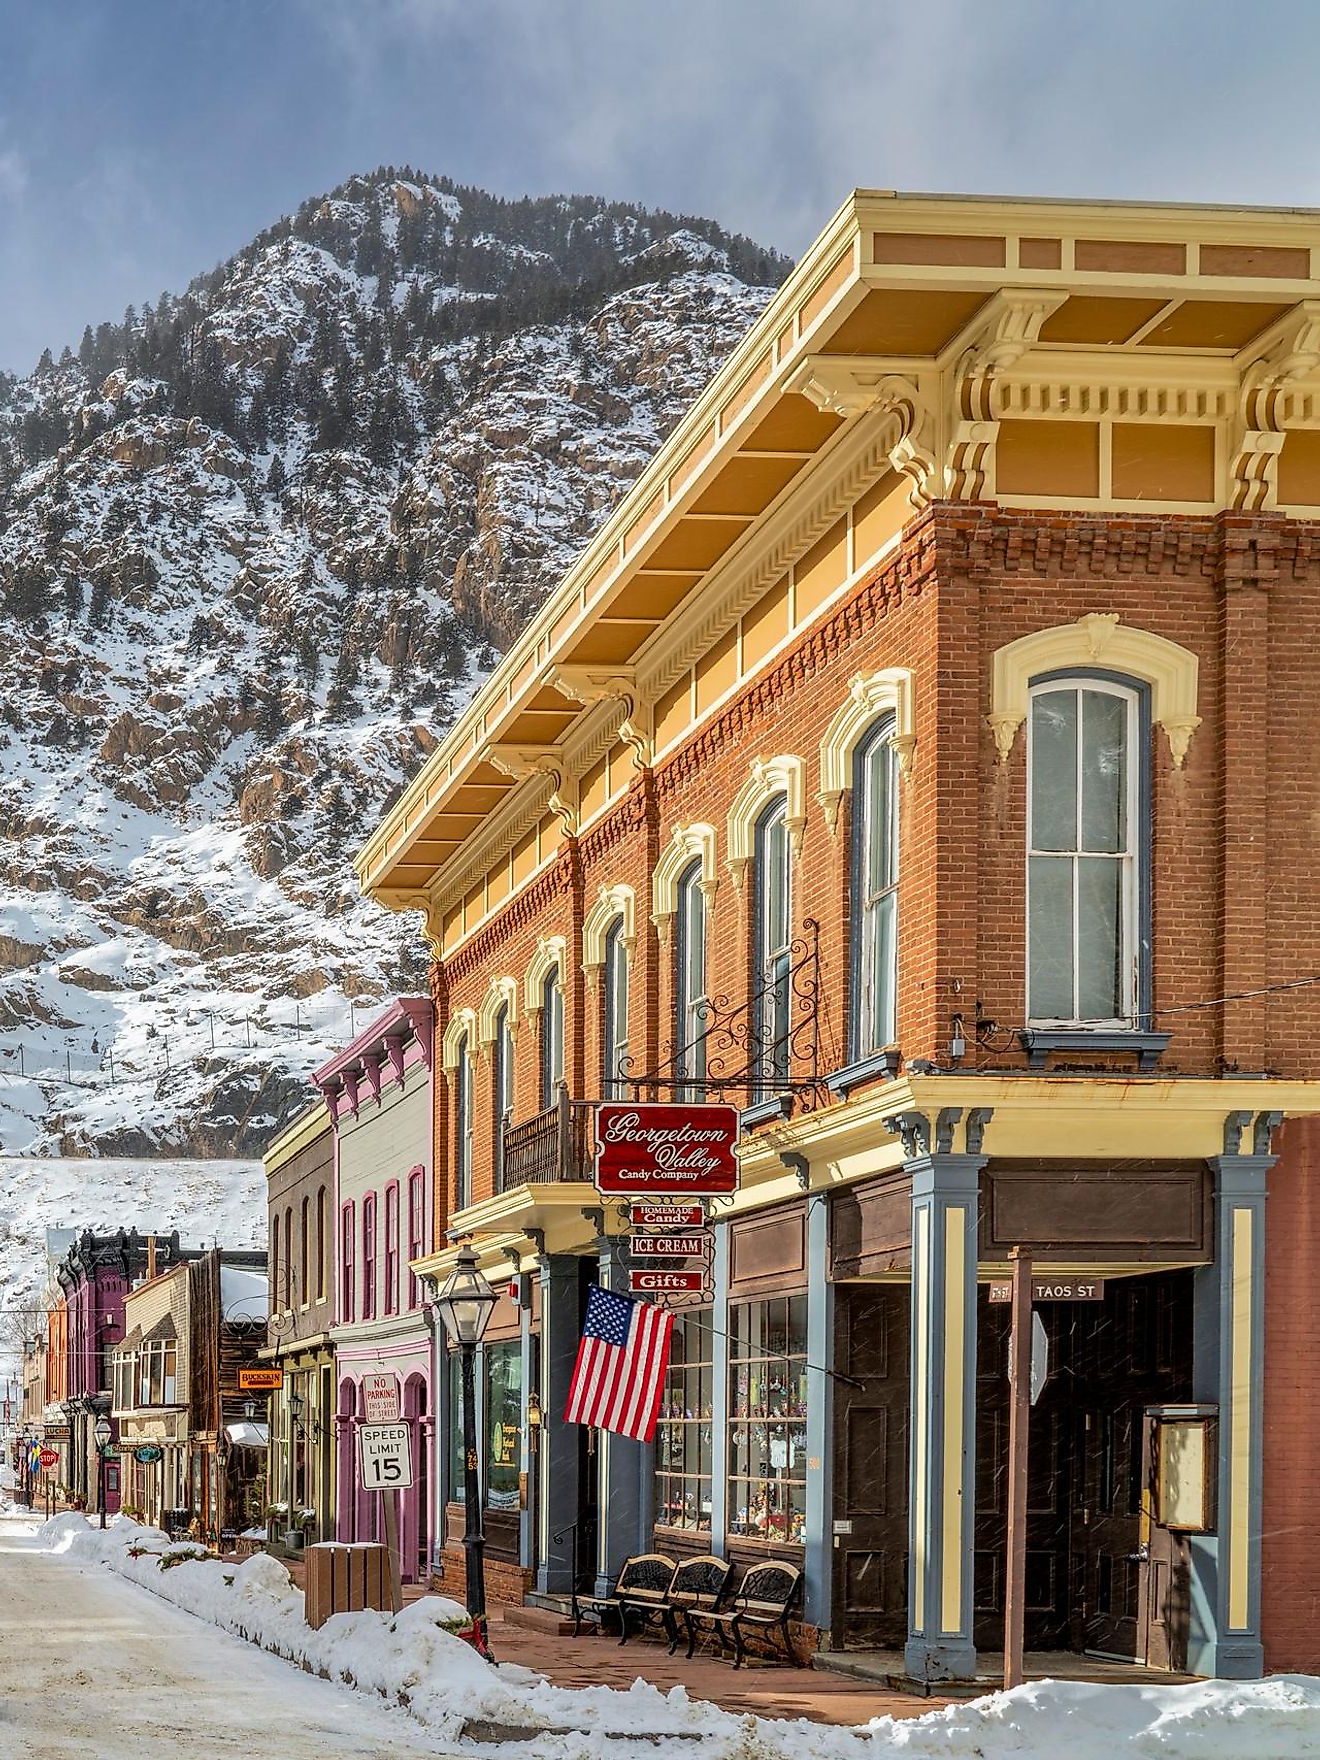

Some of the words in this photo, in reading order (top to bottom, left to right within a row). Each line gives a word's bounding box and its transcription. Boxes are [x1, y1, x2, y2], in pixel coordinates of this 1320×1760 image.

[605, 1112, 728, 1152] Georgetown
[655, 1143, 721, 1176] Valley
[618, 1169, 651, 1180] Candy
[652, 1169, 699, 1180] Company
[640, 1206, 694, 1214] HOMEMADE
[643, 1213, 690, 1224] Candy
[634, 1238, 654, 1252] ICE
[656, 1239, 699, 1253] CREAM
[639, 1274, 688, 1288] Gifts
[1036, 1286, 1072, 1297] TAOS
[1077, 1286, 1095, 1297] ST
[242, 1373, 280, 1381] BUCKSKIN
[373, 1378, 387, 1389] NO
[367, 1389, 395, 1400] PARKING
[369, 1402, 381, 1410] THIS
[364, 1430, 406, 1441] SPEED
[369, 1444, 402, 1455] LIMIT
[40, 1454, 55, 1463] STOP
[372, 1458, 402, 1482] 15
